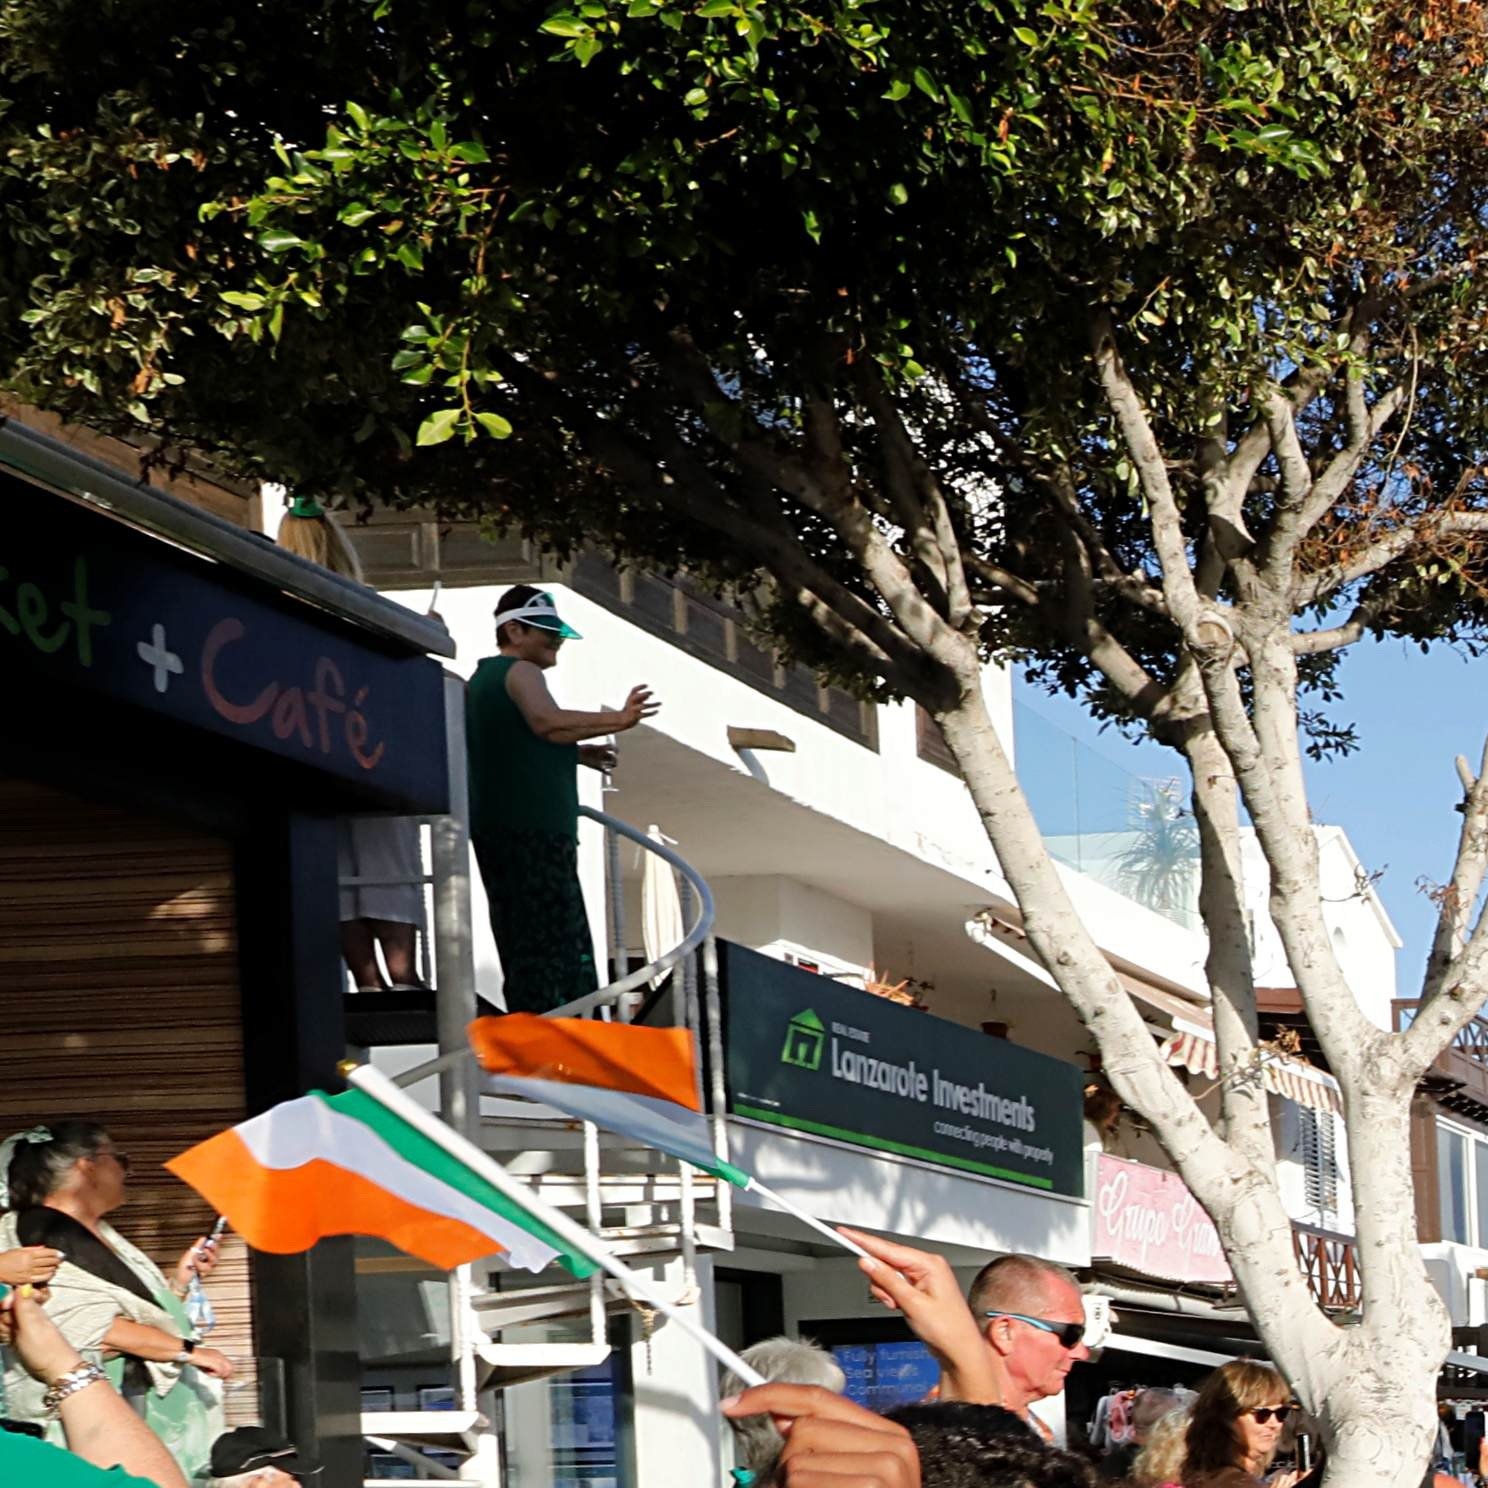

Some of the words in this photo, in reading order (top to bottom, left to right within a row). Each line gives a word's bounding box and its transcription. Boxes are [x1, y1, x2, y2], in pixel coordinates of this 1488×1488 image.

[202, 618, 384, 769] Café
[831, 1037, 928, 1102] Lanzarote
[932, 1069, 1036, 1132] Investments
[934, 1120, 979, 1147] connecting
[979, 1132, 1008, 1152] people
[1023, 1143, 1054, 1166] property
[1100, 1171, 1167, 1262] Grupo
[846, 1367, 873, 1379] Sea
